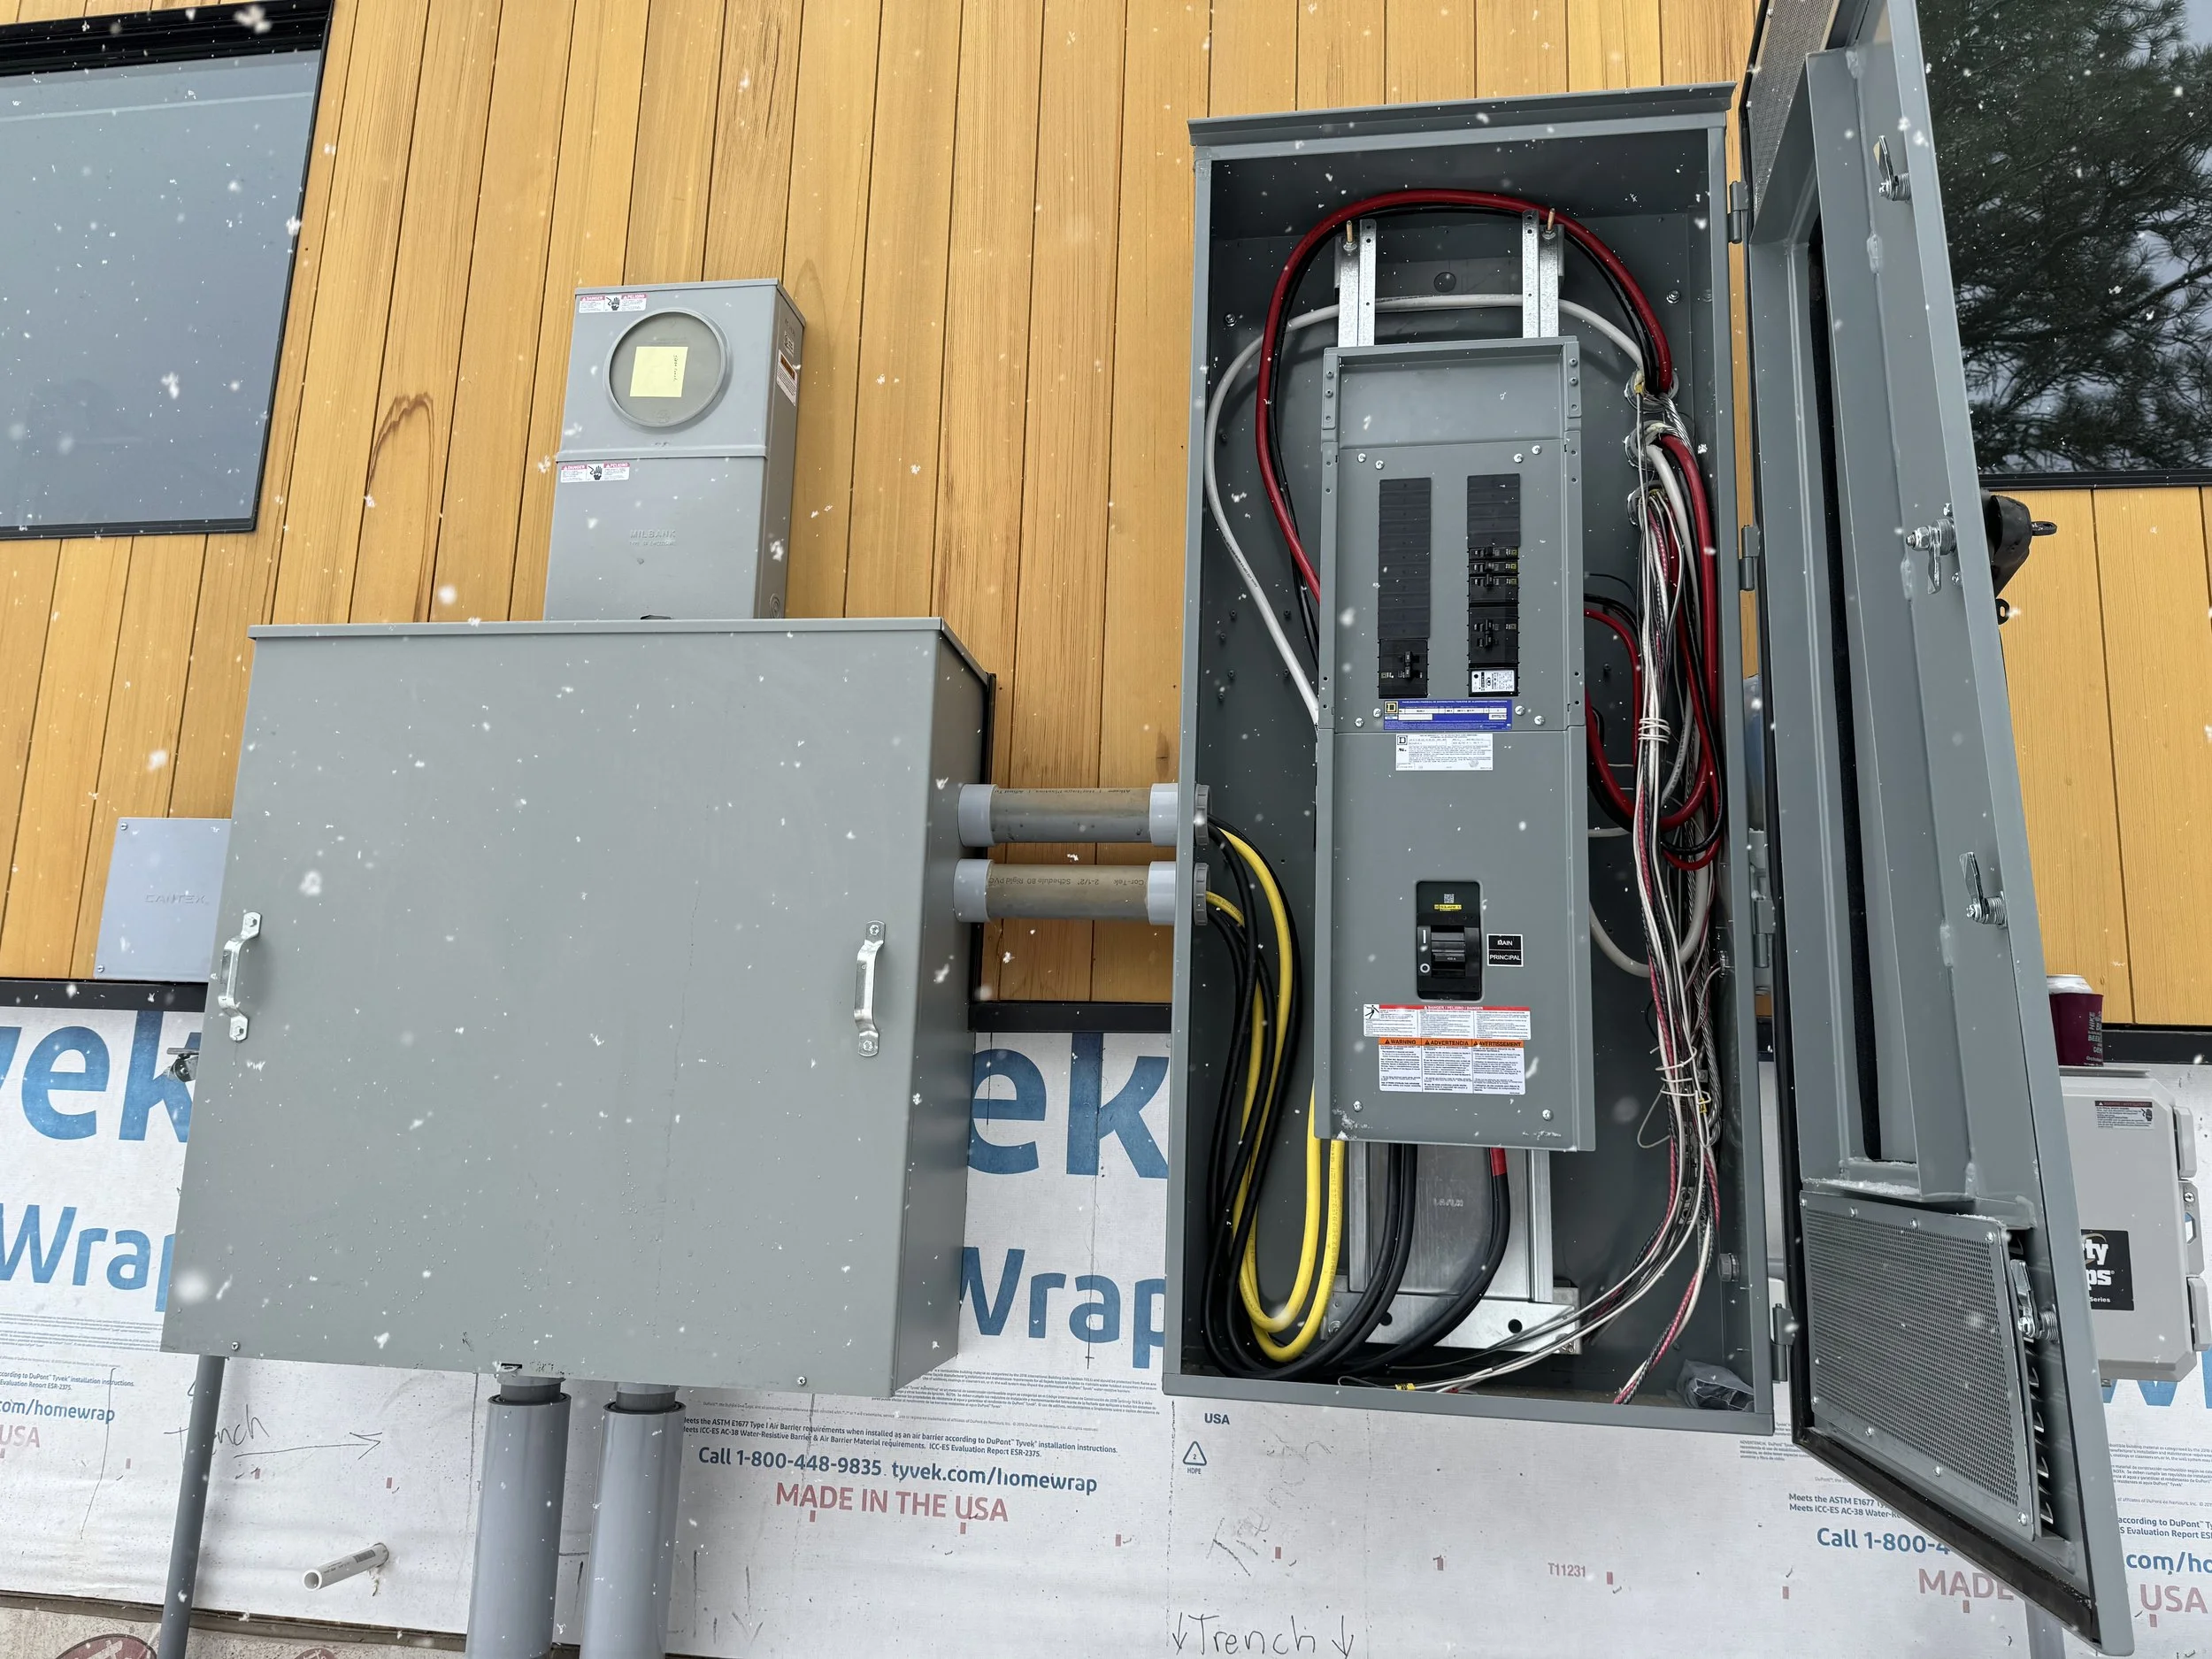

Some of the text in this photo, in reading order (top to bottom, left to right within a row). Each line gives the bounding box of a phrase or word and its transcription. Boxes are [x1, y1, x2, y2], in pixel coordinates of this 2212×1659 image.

[1005, 877, 1024, 886] Rigid
[71, 1376, 101, 1385] installation
[102, 1379, 134, 1387] instructions.
[1204, 1413, 1231, 1425] USA
[699, 1426, 719, 1435] ICC-ES
[740, 1430, 789, 1440] Water-Resistive
[790, 1432, 812, 1441] Barrier
[854, 1437, 880, 1447] Material
[881, 1440, 926, 1449] requirements.
[929, 1442, 950, 1451] ICC-ES
[950, 1443, 986, 1454] Evaluation
[987, 1446, 1010, 1455] Report
[1010, 1448, 1042, 1458] ESR-2375.
[731, 1419, 749, 1428] E1677
[749, 1421, 765, 1430] Type
[780, 1423, 802, 1432] Barrier
[803, 1425, 845, 1434] requirements
[921, 1432, 944, 1441] barrier
[944, 1434, 977, 1445] according
[1038, 1440, 1076, 1451] installation
[1077, 1443, 1118, 1453] instructions.
[698, 1447, 1098, 1495] Call 1-800-448-9835 tyvek.com/homewrap
[776, 1481, 1009, 1522] MADE IN THE USA
[1788, 1493, 1875, 1507] Meets the ASTM E1677
[1789, 1503, 1814, 1513] Meets
[1815, 1505, 1839, 1515] ICC-ES
[1840, 1507, 1863, 1517] AC-38
[1816, 1527, 1859, 1549] Call
[2126, 1527, 2170, 1537] Evaluation
[2171, 1530, 2199, 1540] Report
[1548, 1563, 1586, 1578] T11231
[2139, 1584, 2208, 1614] USA
[1187, 1613, 1317, 1655] Trench
